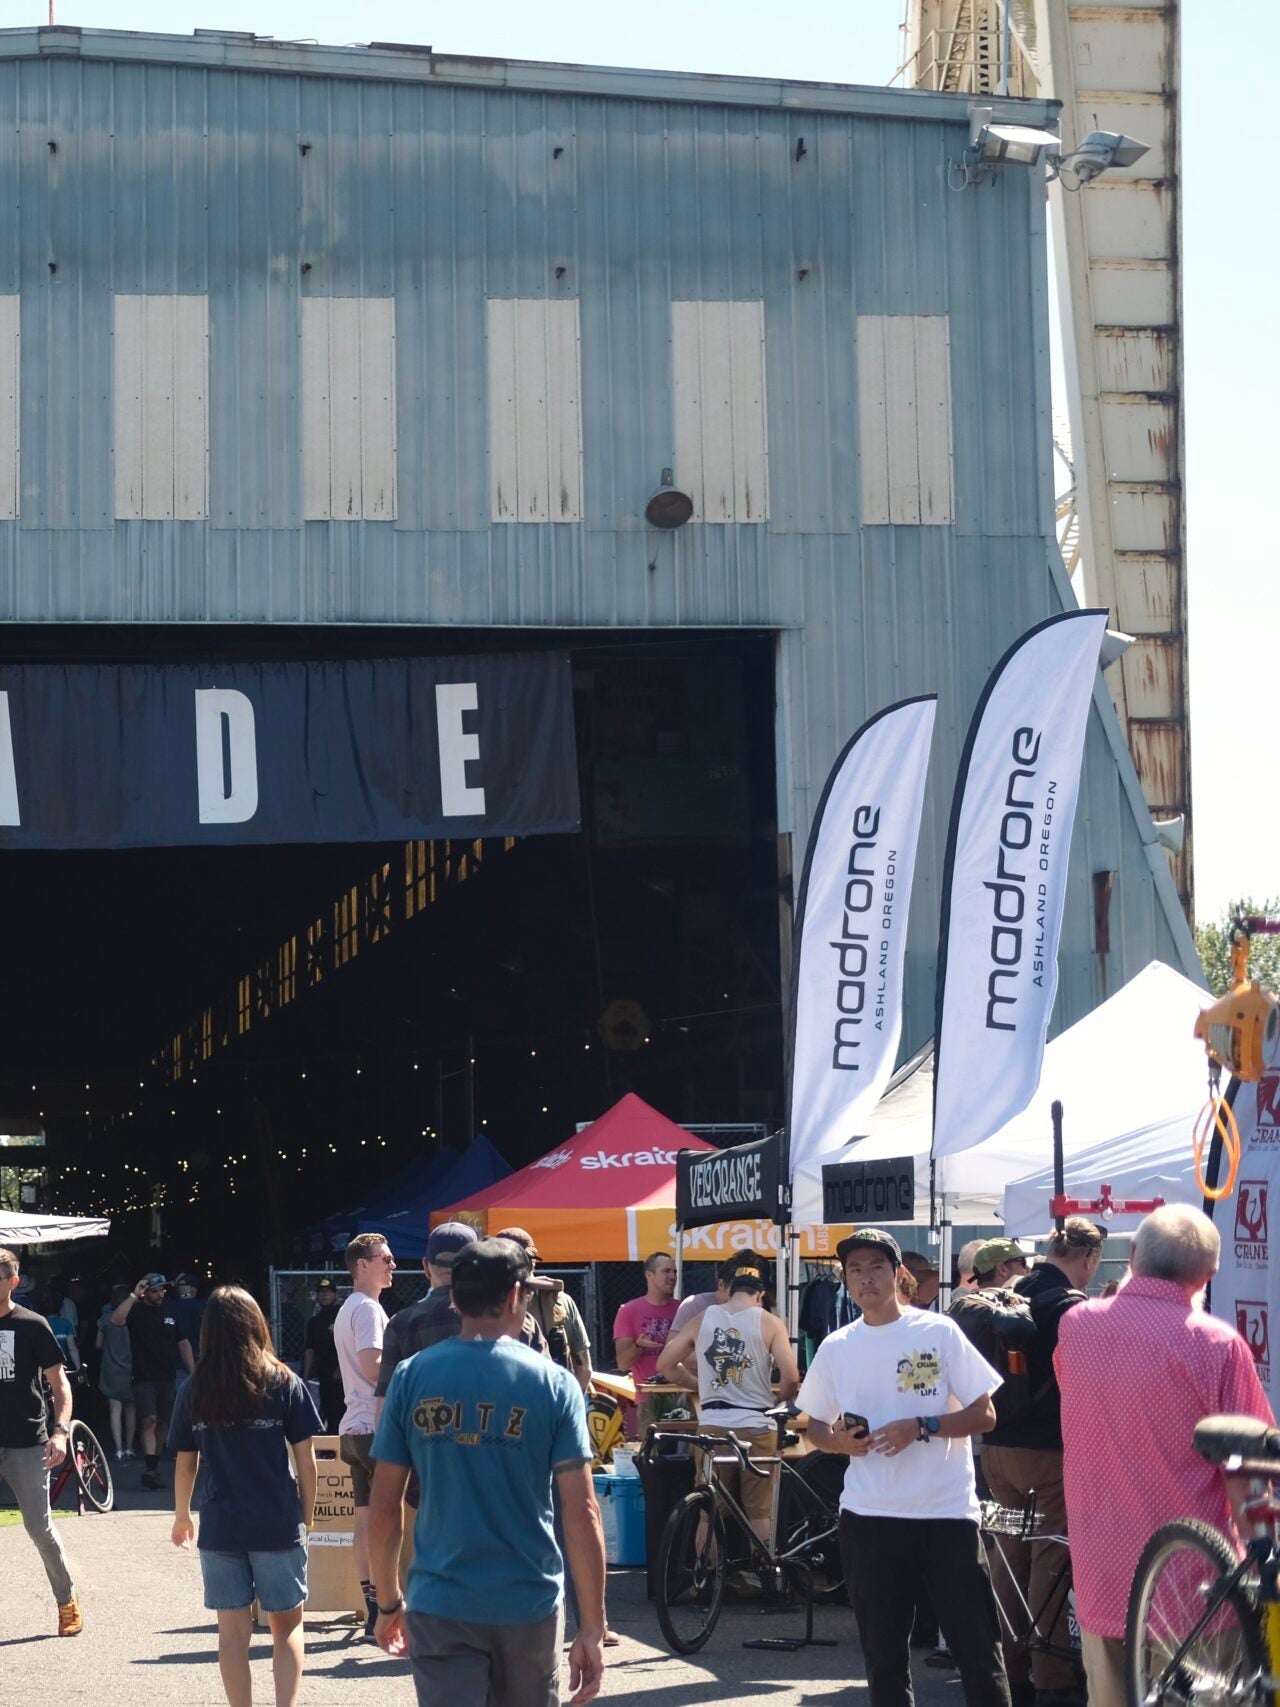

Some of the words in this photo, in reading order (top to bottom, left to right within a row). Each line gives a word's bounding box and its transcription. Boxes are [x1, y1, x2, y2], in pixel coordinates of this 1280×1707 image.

[1039, 781, 1057, 871] OREGON
[982, 726, 1042, 1032] madrone
[829, 805, 881, 1071] madrone
[874, 940, 889, 1032] ASHLAND
[882, 850, 897, 929] OREGON
[1032, 883, 1047, 988] ASHLAND
[580, 1147, 677, 1169] skratc
[825, 1165, 911, 1215] madrone
[1235, 1244, 1269, 1260] CRANE
[313, 1506, 354, 1517] RAILLEU
[334, 1491, 354, 1499] MAD
